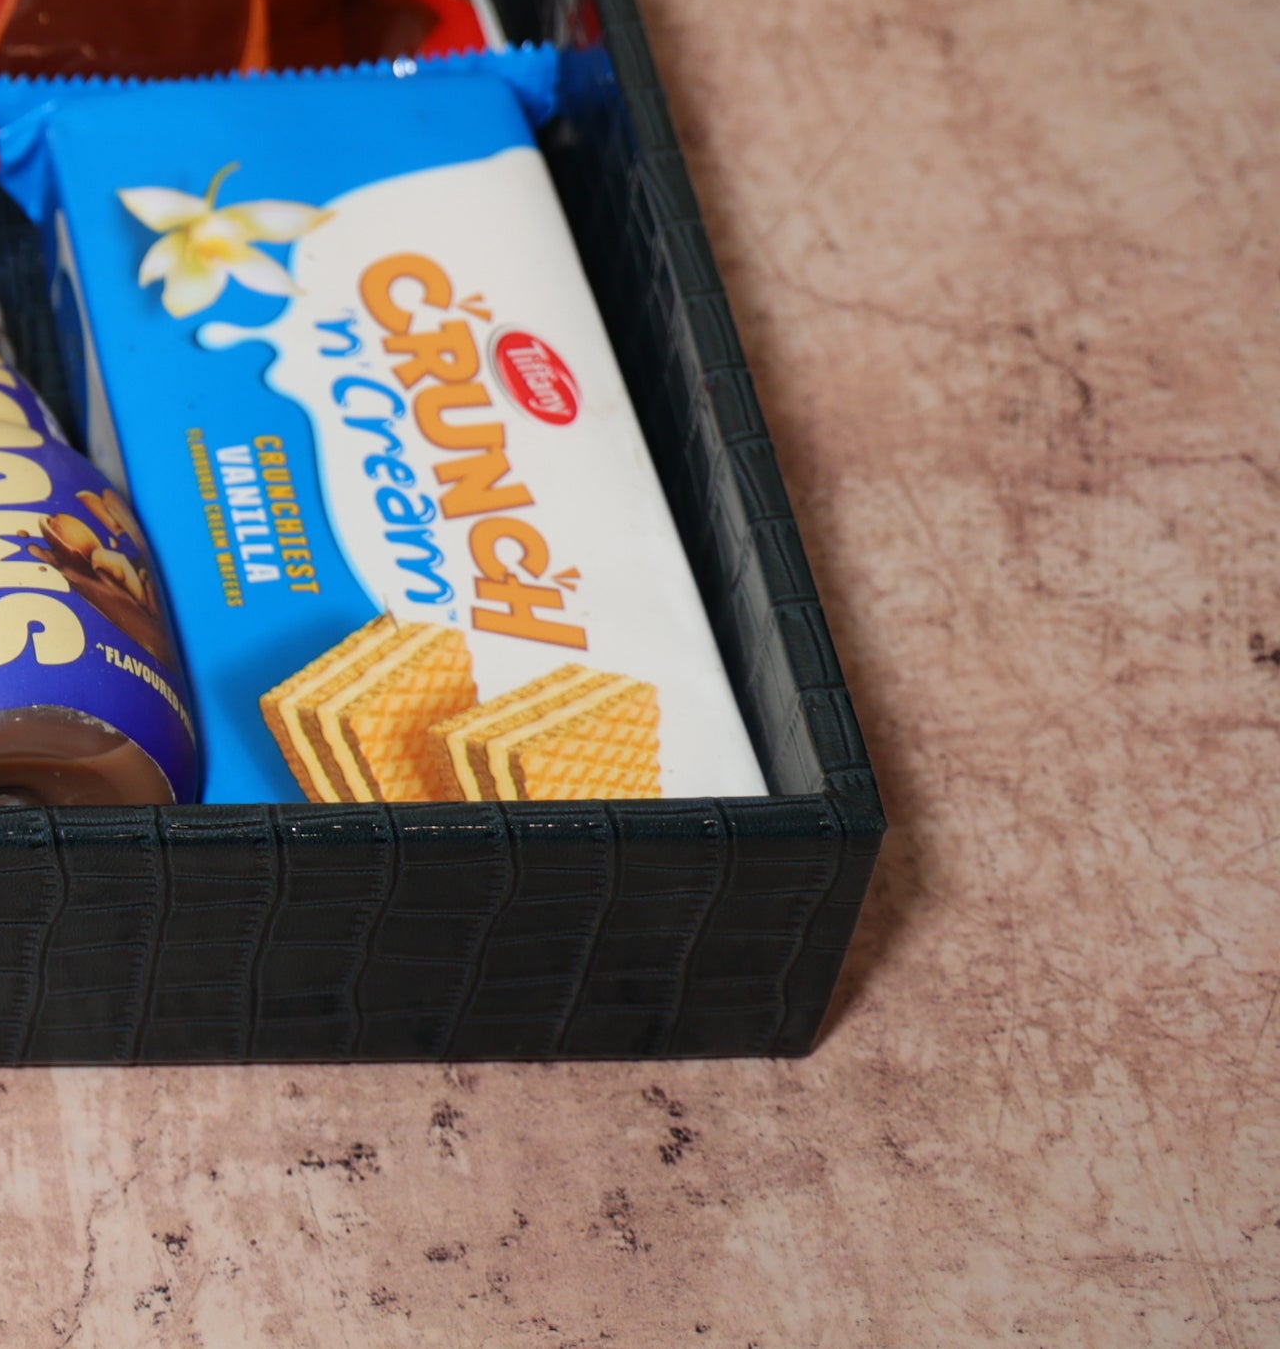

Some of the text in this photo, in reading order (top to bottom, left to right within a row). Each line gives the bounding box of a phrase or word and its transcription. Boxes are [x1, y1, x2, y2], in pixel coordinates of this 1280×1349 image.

[216, 444, 281, 584] VANILLA
[253, 435, 320, 595] CRUNCHIEST
[331, 374, 456, 605] Cream
[358, 253, 588, 652] CRUNCH
